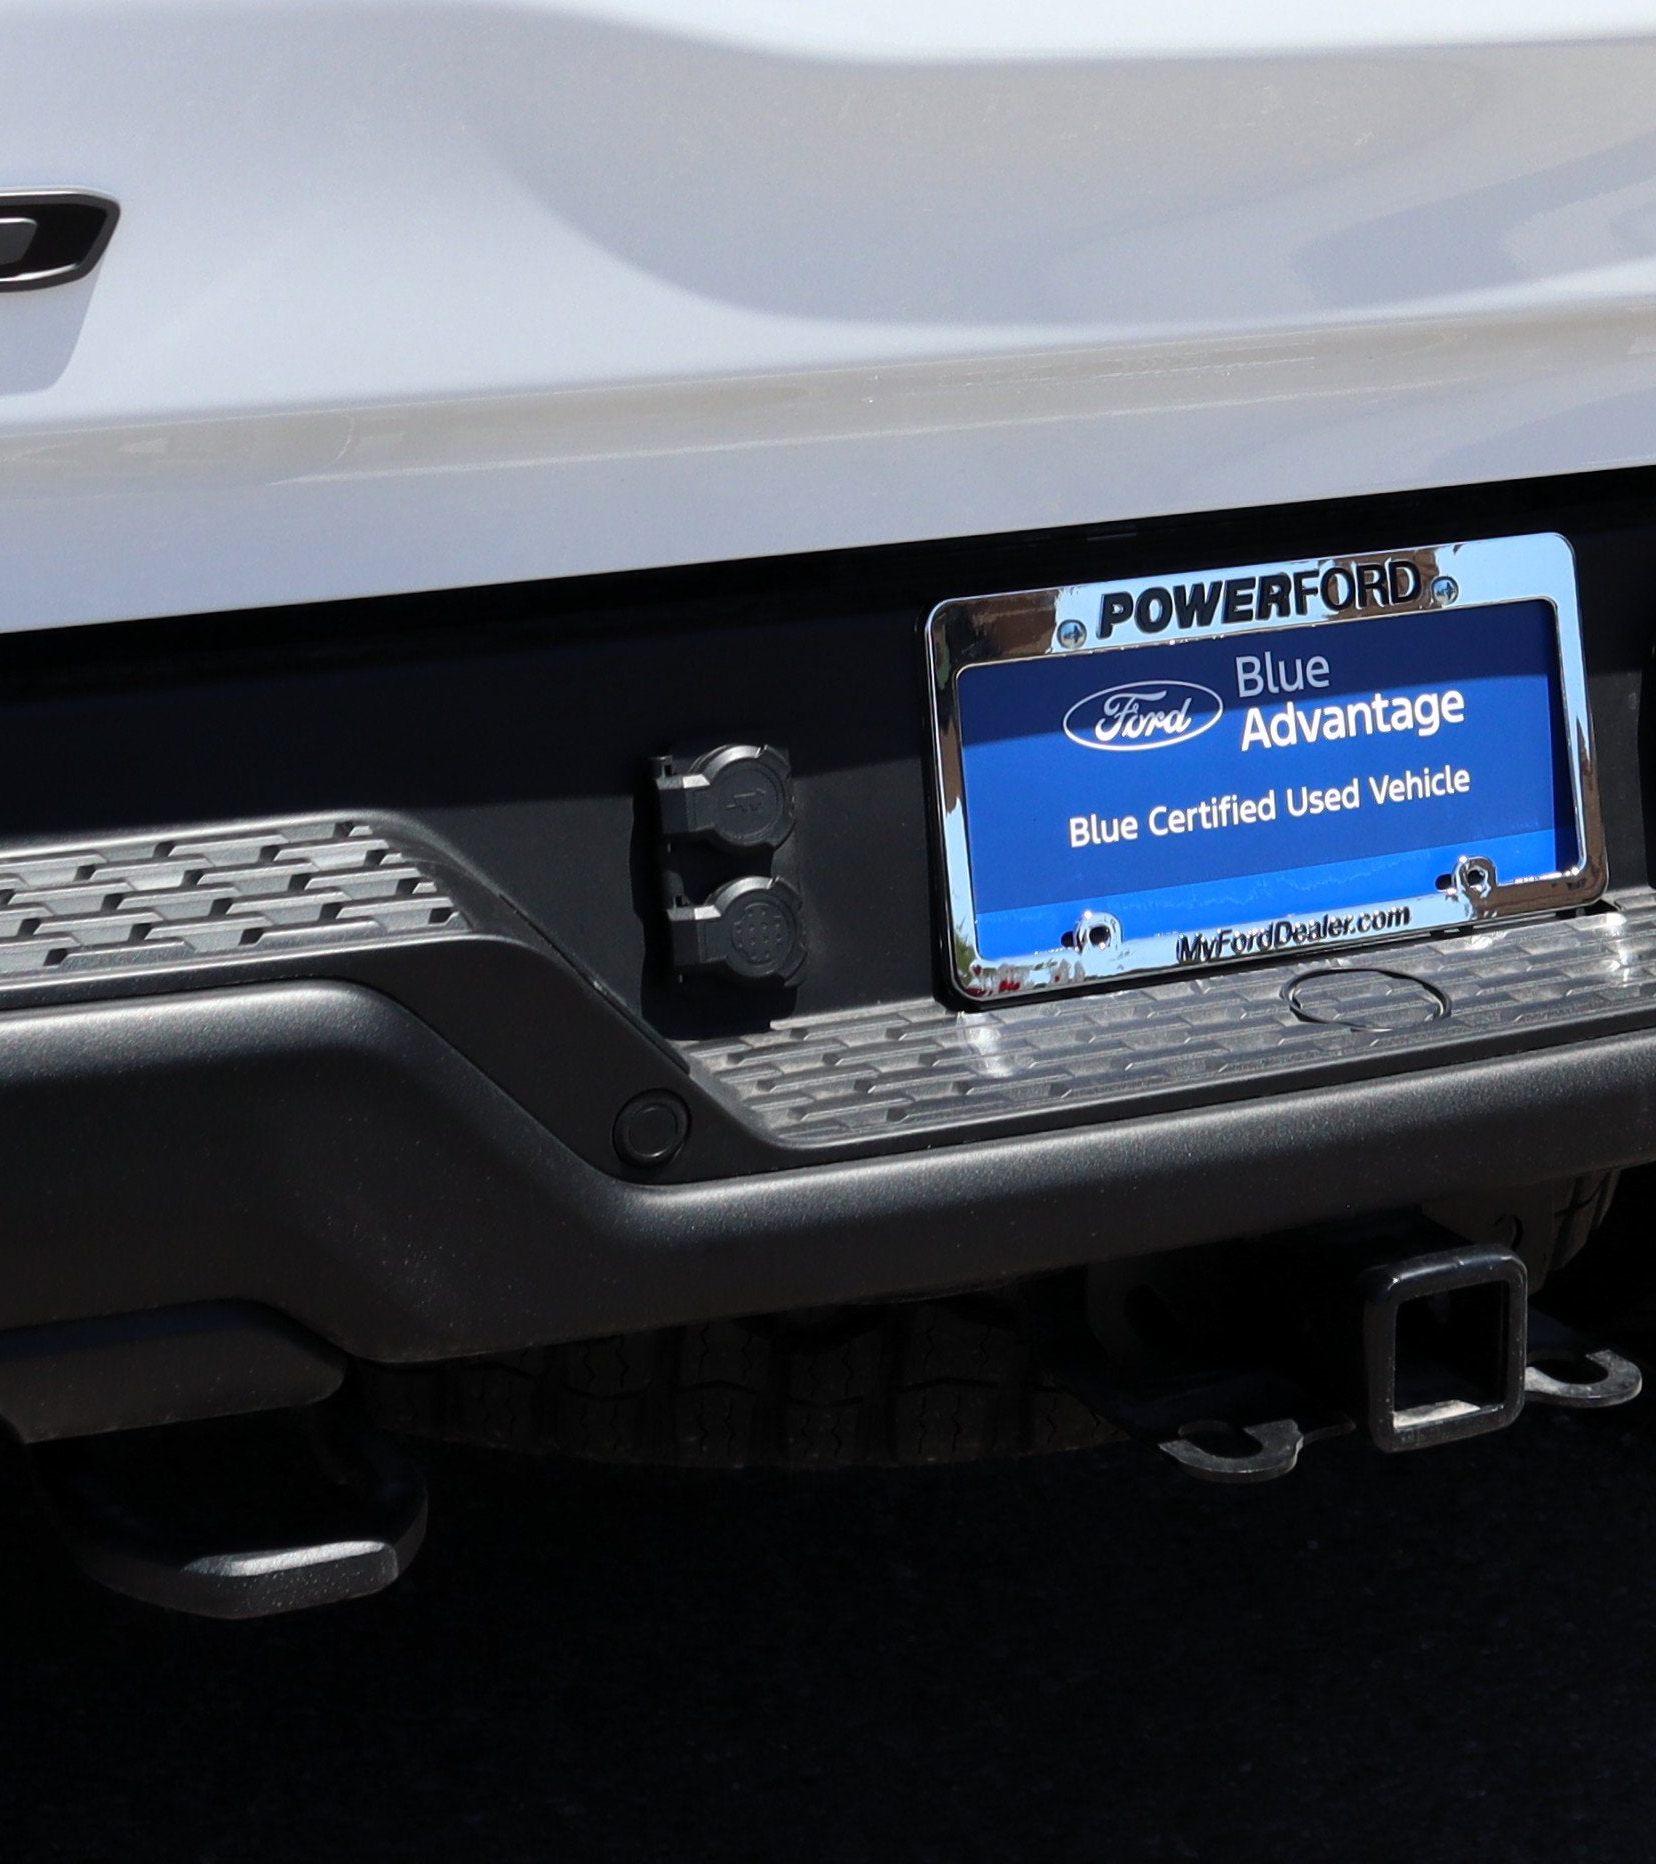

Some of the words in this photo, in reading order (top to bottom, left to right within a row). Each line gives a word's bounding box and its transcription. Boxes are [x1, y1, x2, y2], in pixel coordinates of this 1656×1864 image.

[1096, 560, 1422, 639] POWERFORD
[1235, 651, 1331, 698] Blue
[1093, 691, 1193, 741] Ford
[1240, 690, 1466, 752] Advantage
[1069, 813, 1138, 848] Blue
[1148, 795, 1277, 836] Certified
[1286, 785, 1361, 817] Used
[1368, 765, 1471, 802] Vehicle
[1176, 905, 1411, 963] MyFordDealer.com
